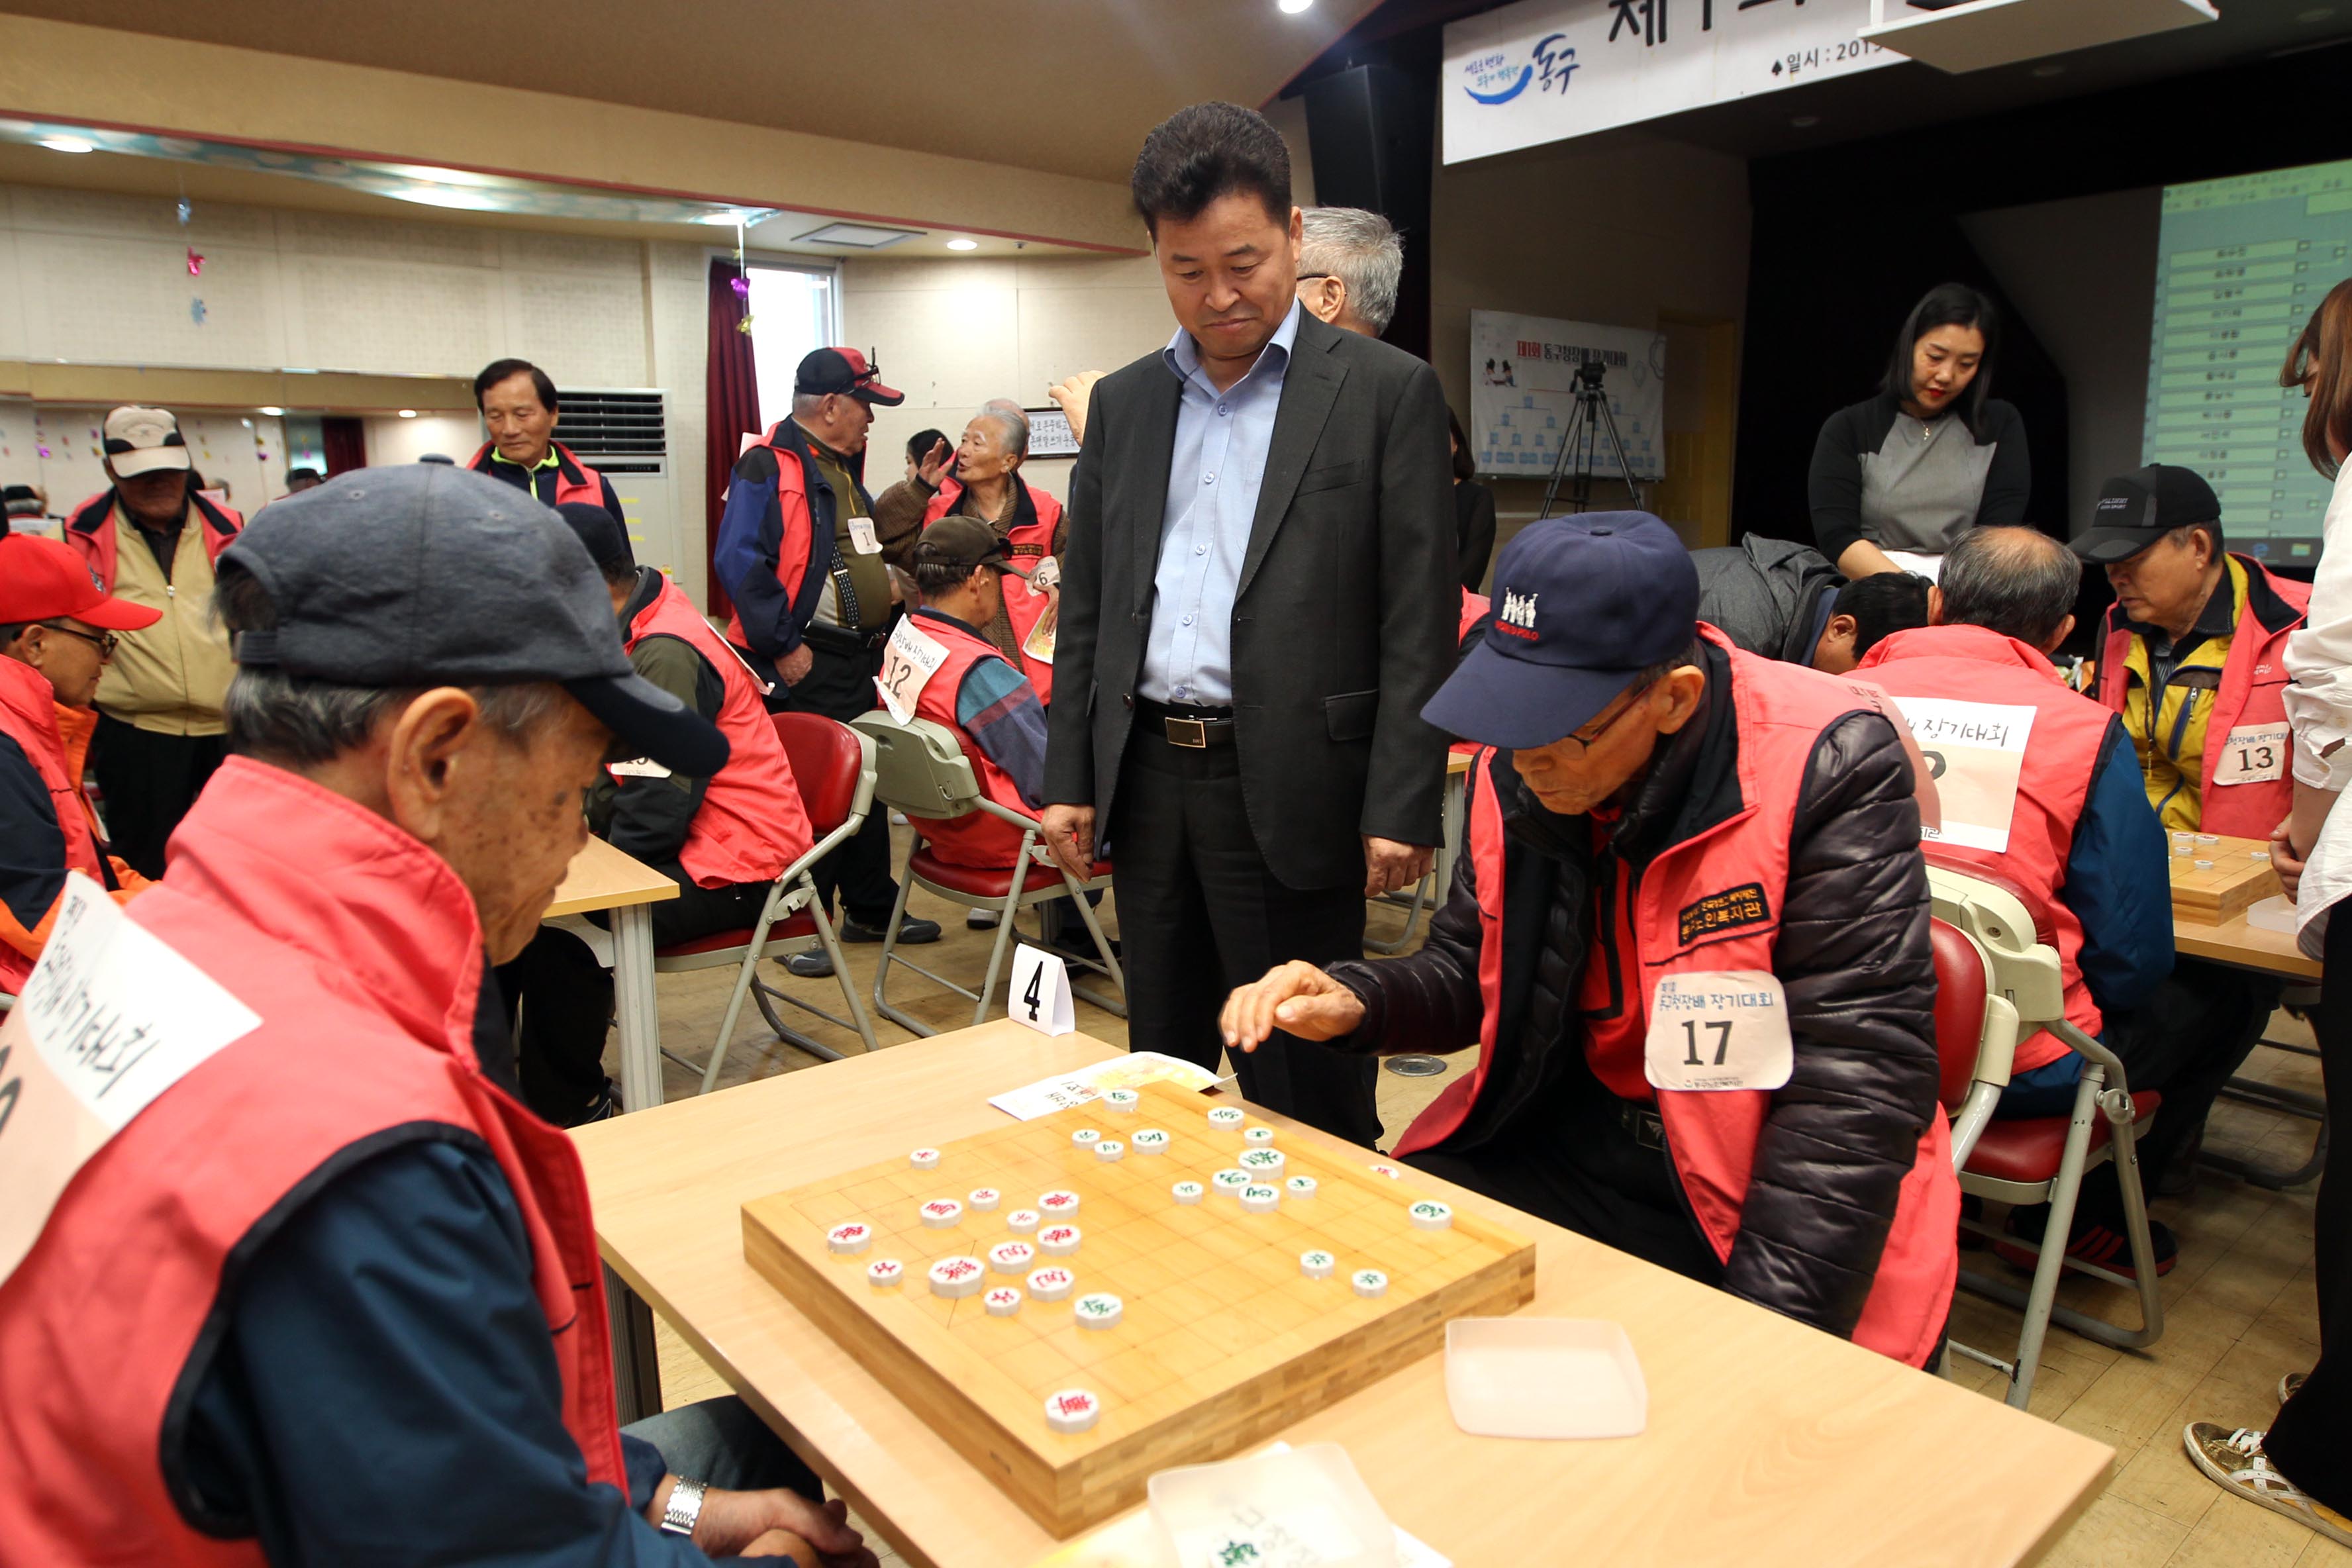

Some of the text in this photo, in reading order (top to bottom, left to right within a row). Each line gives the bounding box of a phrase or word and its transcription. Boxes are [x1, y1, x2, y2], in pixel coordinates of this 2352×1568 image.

[1485, 53, 1505, 68] 변화
[1532, 32, 1581, 95] 동구
[1787, 48, 1819, 74] 일시
[863, 531, 870, 546] 1
[883, 656, 911, 699] 12
[1923, 718, 2008, 748] 장기대회
[2237, 746, 2274, 772] 13
[1681, 902, 1763, 940] 동구노인복지관
[1023, 961, 1044, 1022] 4
[1659, 992, 1774, 1012] 동구청장배 장기대회
[1681, 1020, 1734, 1066] 17
